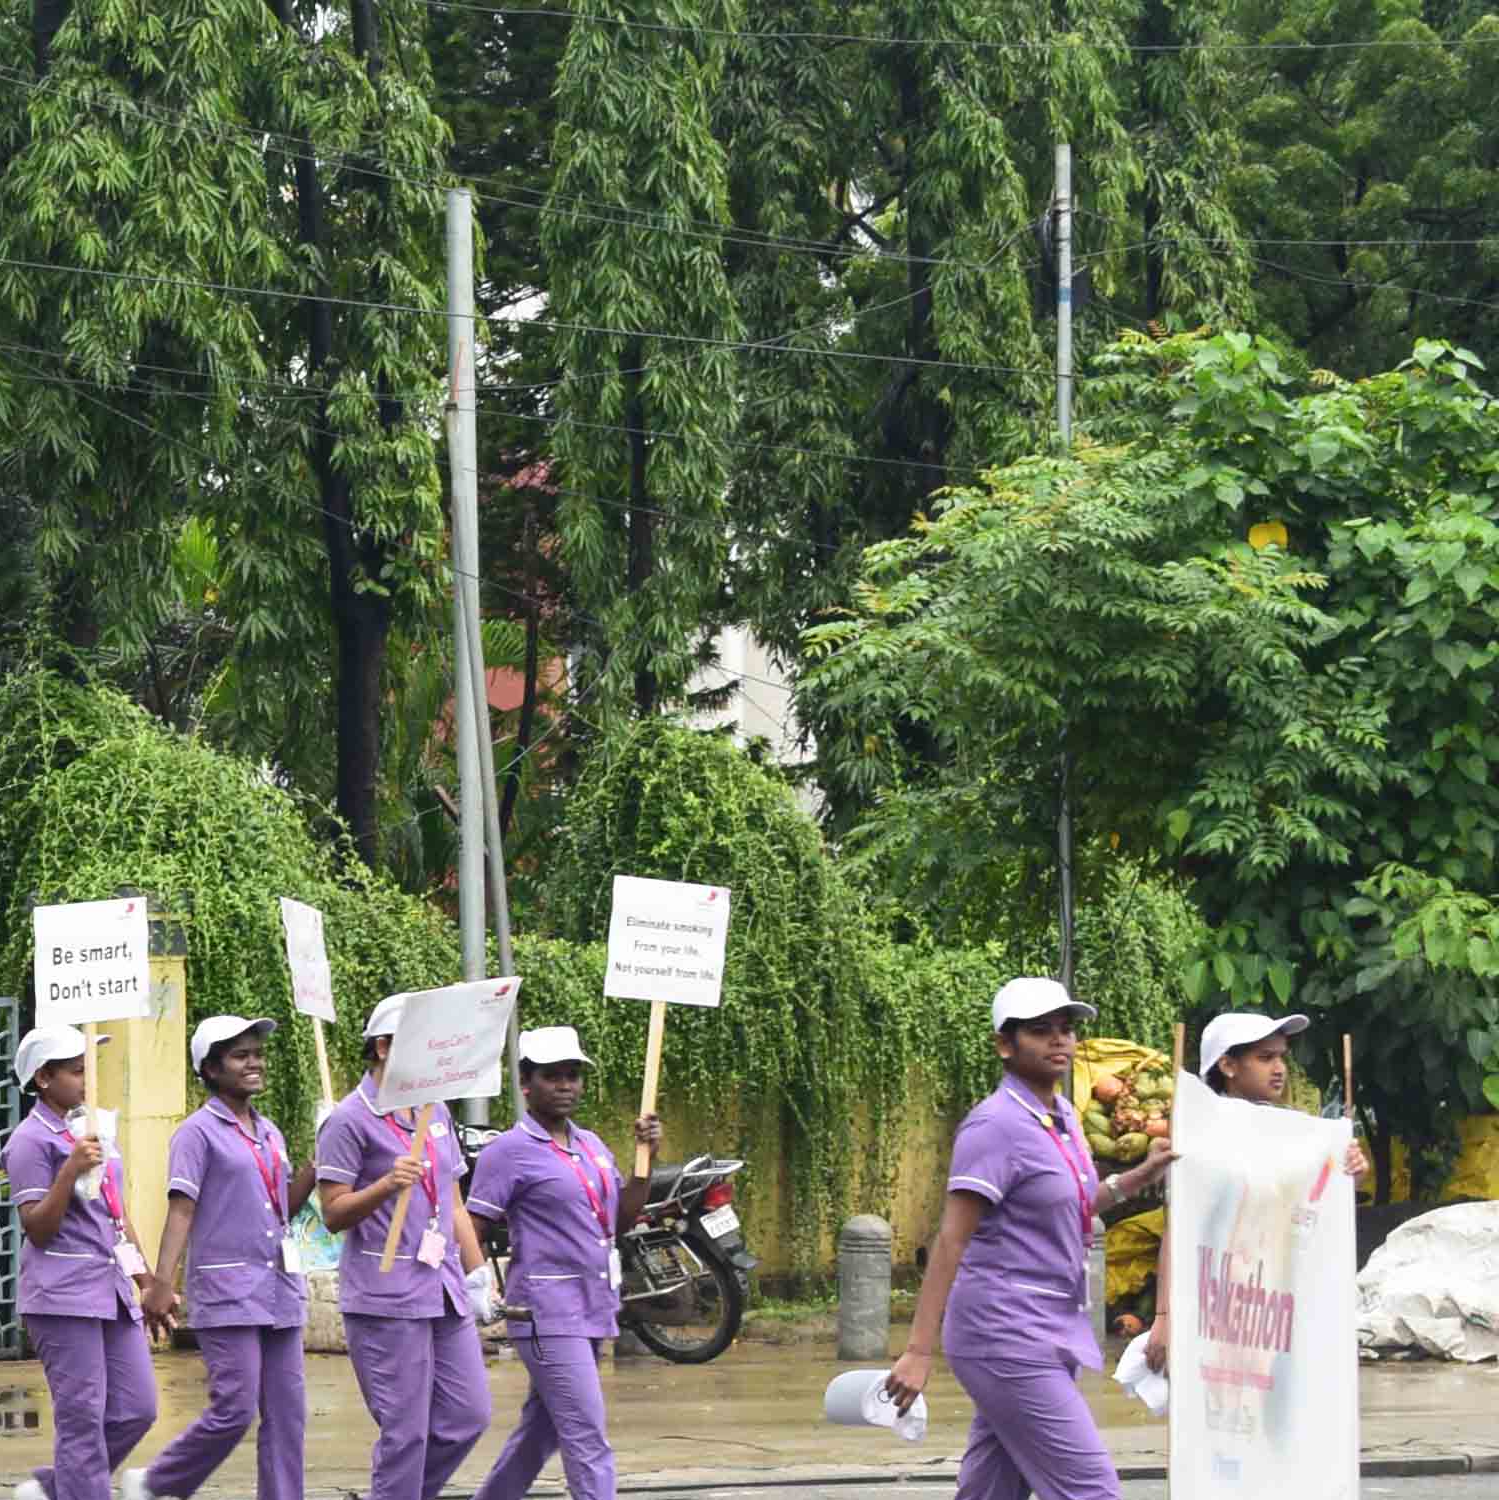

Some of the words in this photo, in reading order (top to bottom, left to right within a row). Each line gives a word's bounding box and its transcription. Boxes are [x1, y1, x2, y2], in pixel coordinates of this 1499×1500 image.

[627, 916, 670, 930] Eliminate
[675, 923, 713, 937] smoking
[53, 947, 74, 966] Be
[79, 941, 132, 963] smart,
[635, 940, 657, 951] From
[50, 979, 92, 1001] Don't
[98, 976, 138, 995] start
[1198, 1245, 1295, 1352] Walkathon
